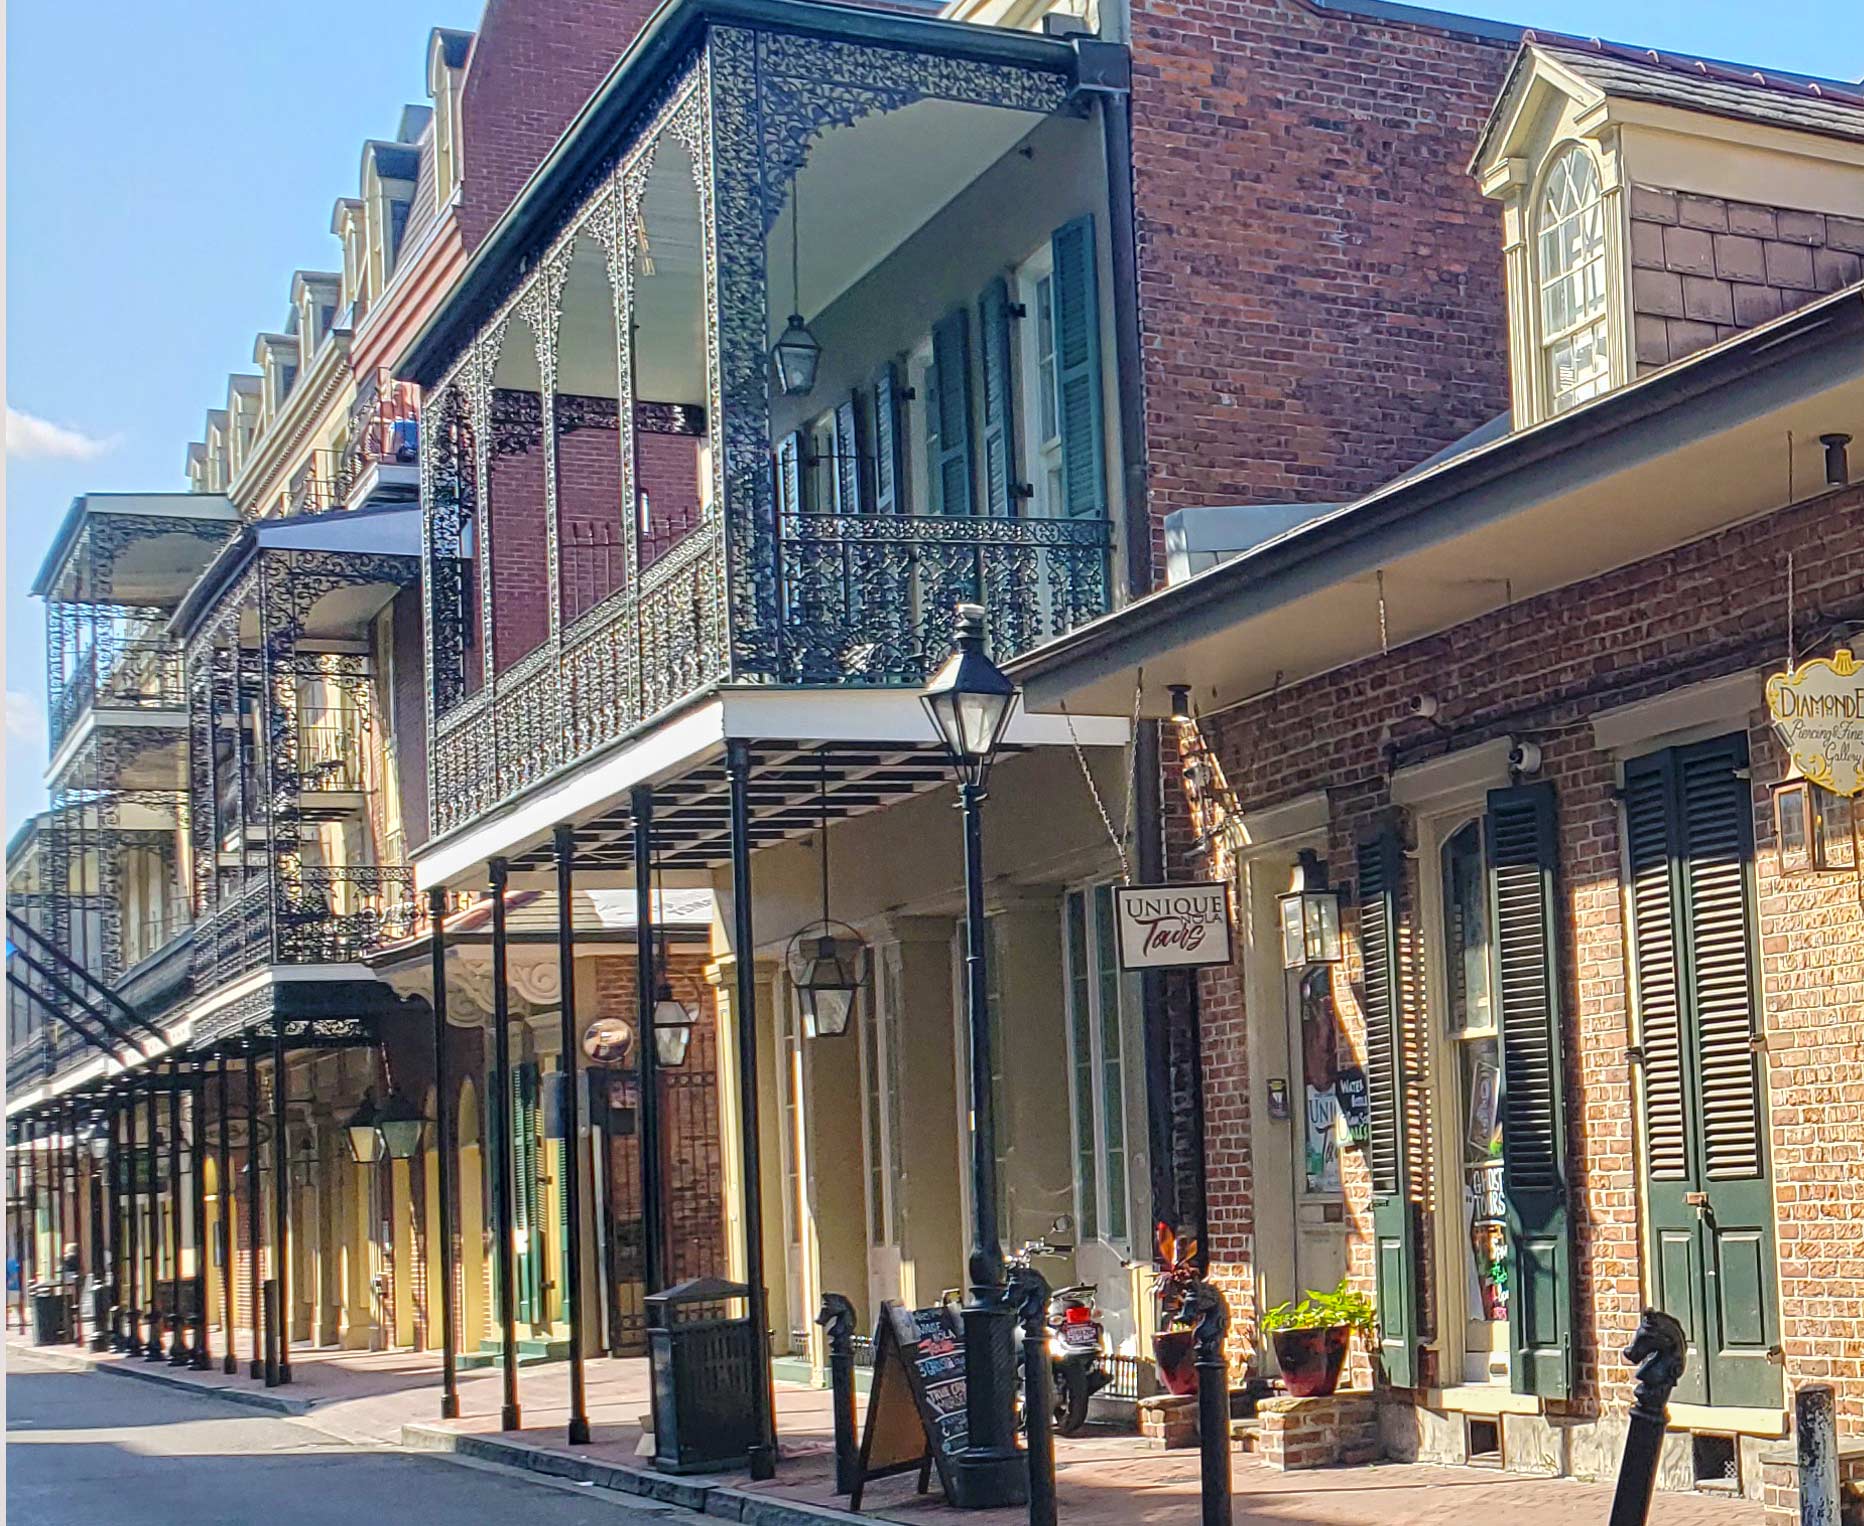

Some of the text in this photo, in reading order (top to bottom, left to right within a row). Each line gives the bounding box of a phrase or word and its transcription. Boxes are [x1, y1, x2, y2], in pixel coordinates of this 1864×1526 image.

[1837, 720, 1864, 740] Fine
[1824, 741, 1862, 772] Gallery
[1125, 896, 1222, 917] UNIQUE
[1134, 916, 1206, 957] Tours
[1473, 1167, 1505, 1194] GHOST
[1473, 1192, 1506, 1220] TOURS
